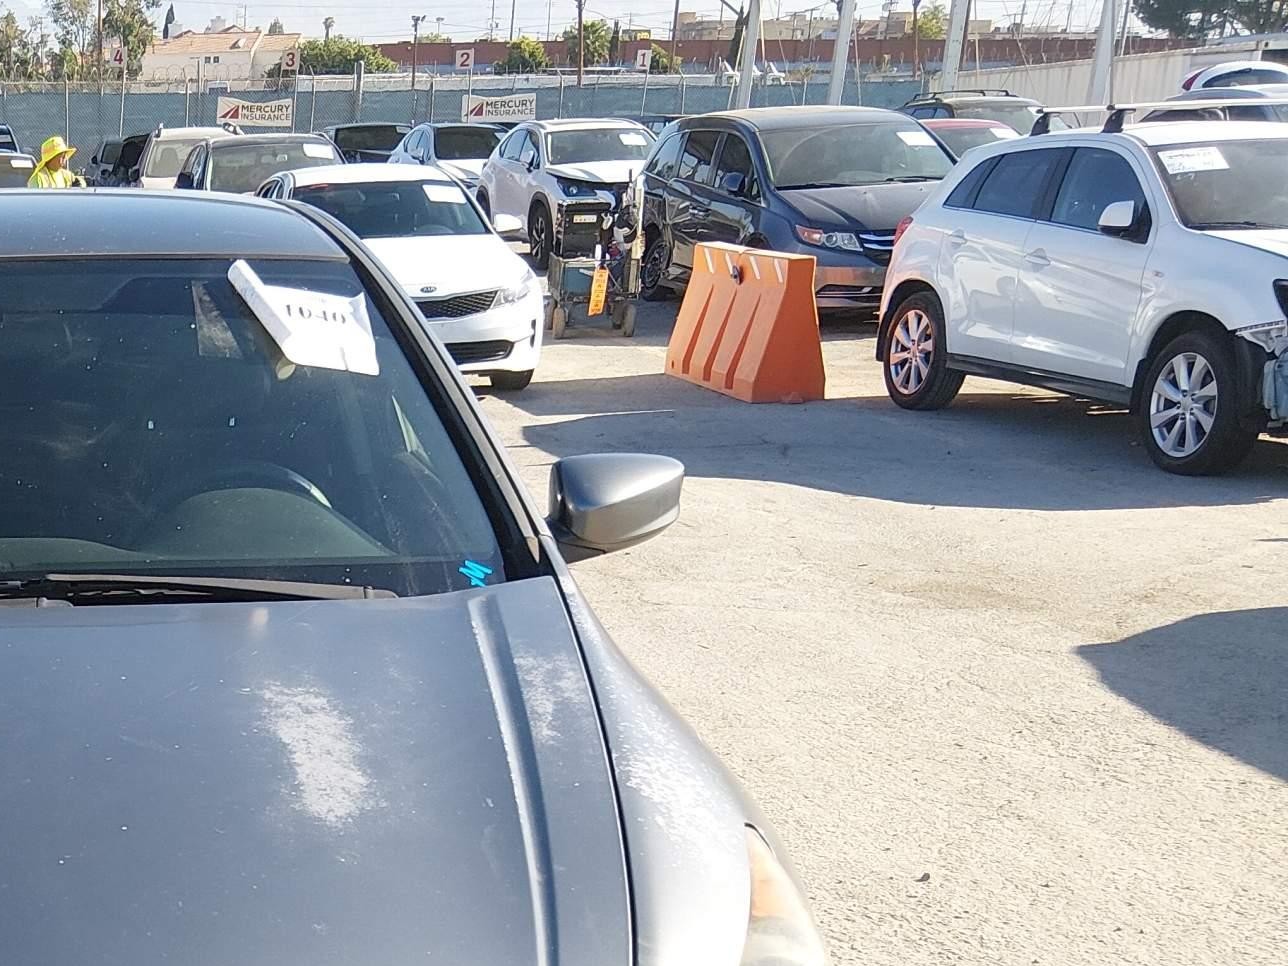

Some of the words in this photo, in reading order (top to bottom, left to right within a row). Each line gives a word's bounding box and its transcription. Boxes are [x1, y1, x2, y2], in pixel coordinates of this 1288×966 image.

[112, 49, 123, 65] 4
[285, 52, 295, 68] 3
[459, 52, 470, 68] 2
[638, 52, 648, 68] 1
[241, 104, 290, 113] MERCURY
[485, 99, 534, 109] MERCURY
[241, 113, 291, 121] INSURANCE
[486, 108, 535, 117] INSURANCE
